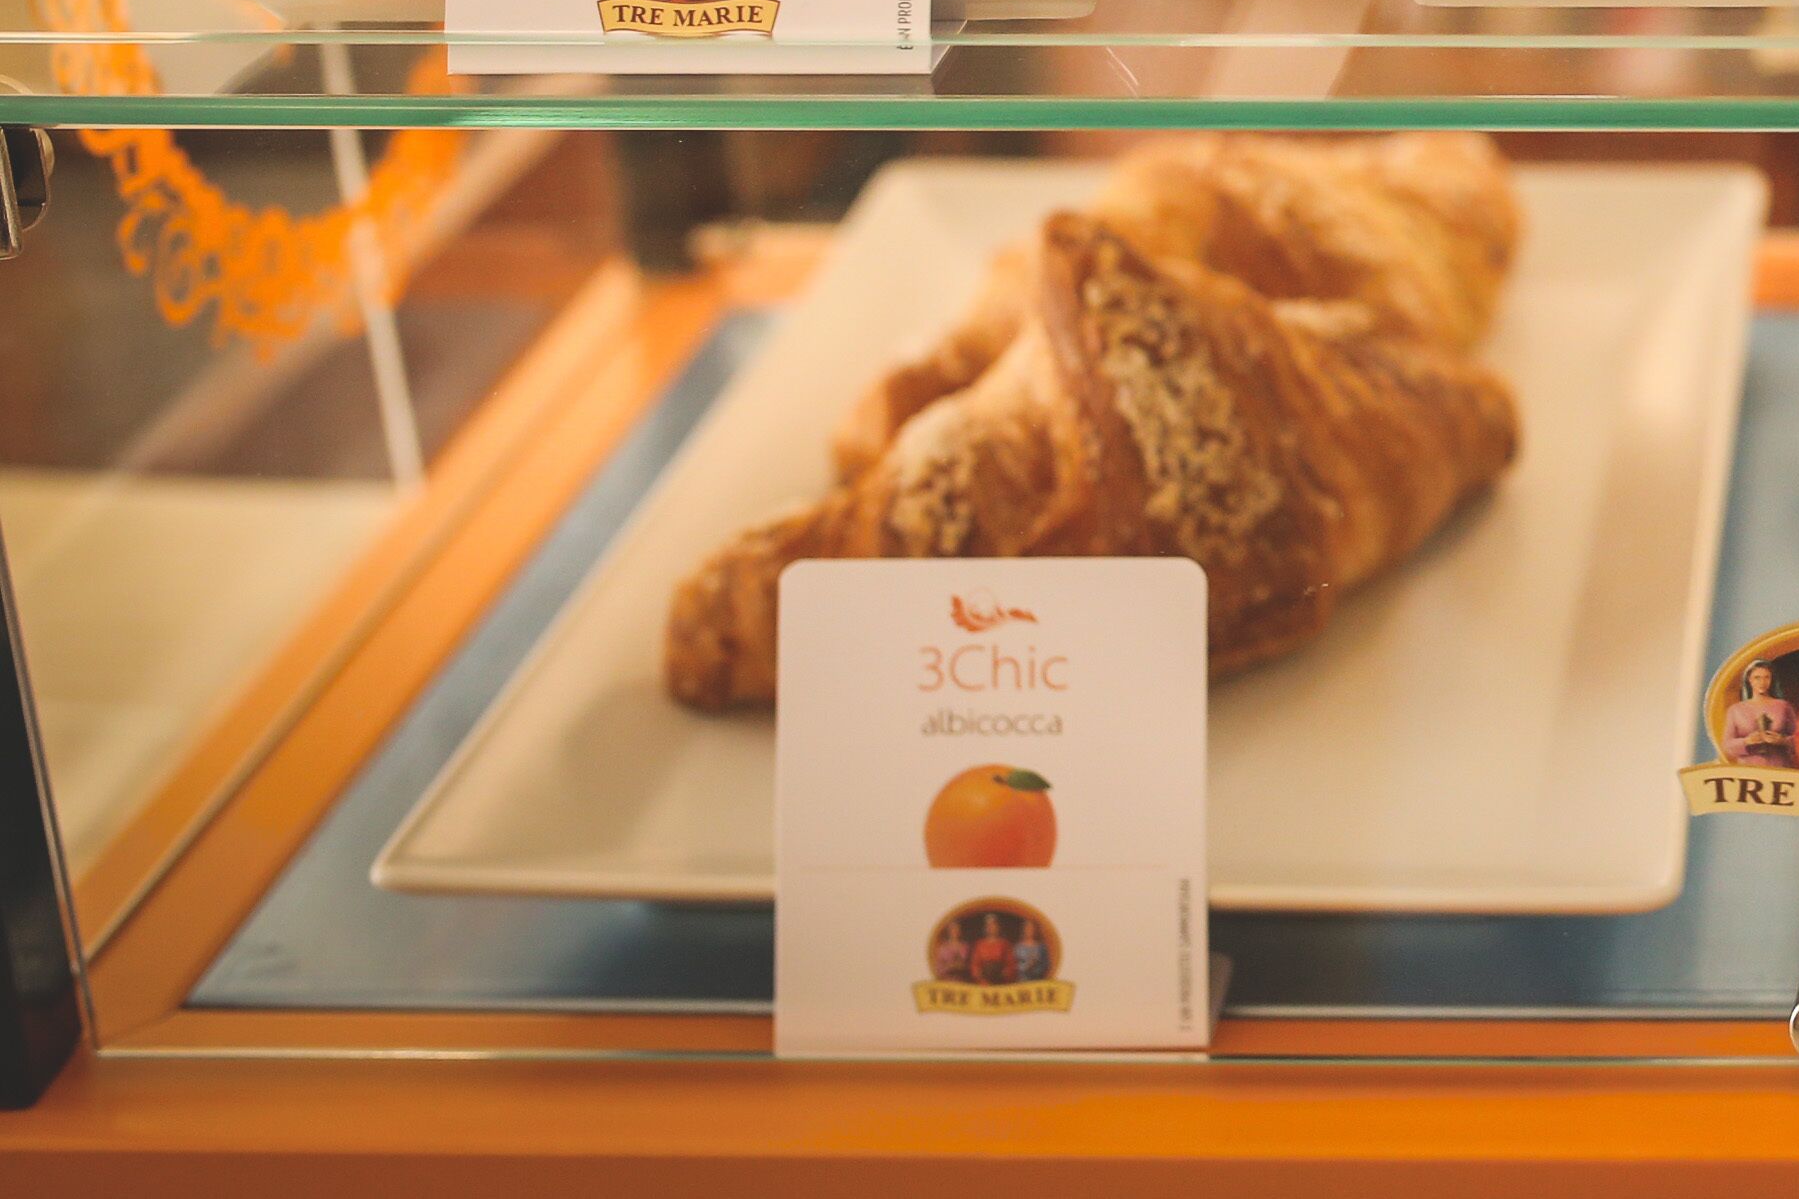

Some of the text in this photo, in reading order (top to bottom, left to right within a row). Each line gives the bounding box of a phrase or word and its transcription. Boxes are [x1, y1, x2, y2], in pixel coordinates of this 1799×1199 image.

[612, 3, 765, 29] TRE MARIE
[917, 644, 1071, 693] 3Chic
[921, 708, 1065, 738] albicocca
[1703, 777, 1796, 807] TRE
[927, 988, 1061, 1008] TRE MARIE
